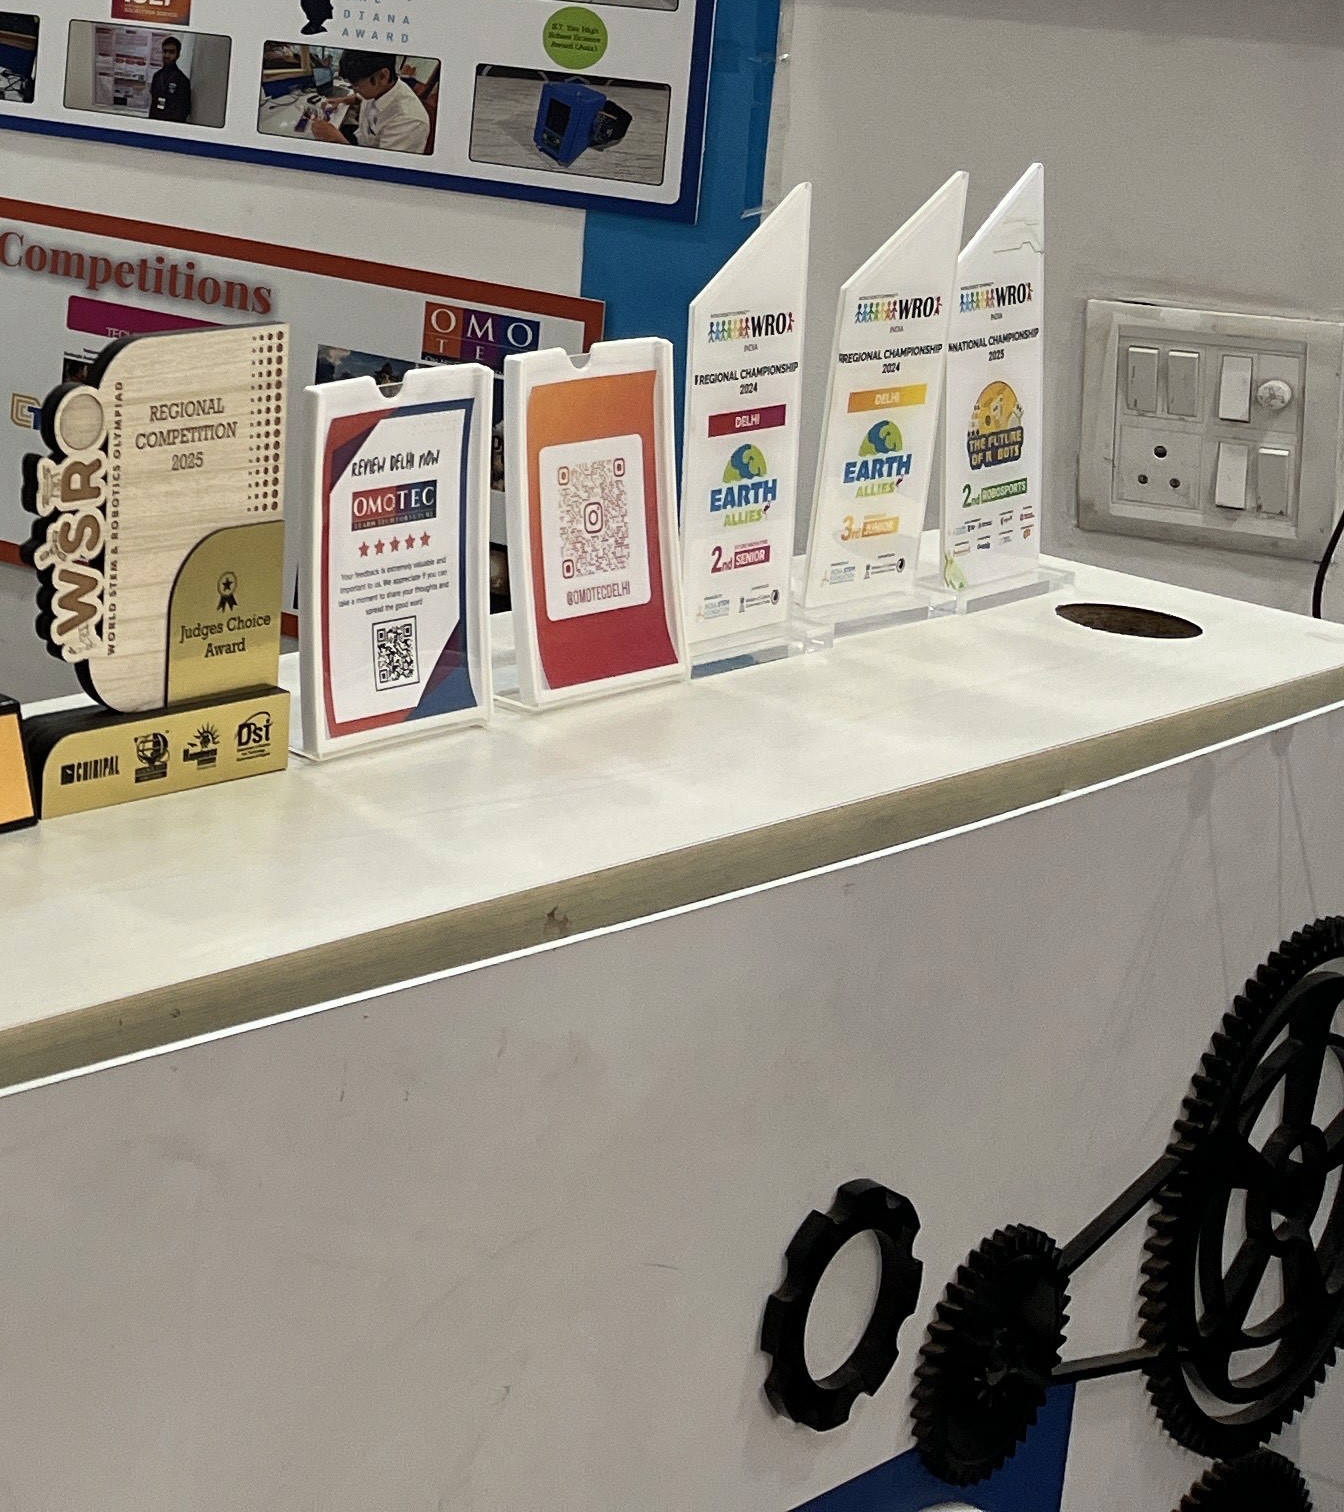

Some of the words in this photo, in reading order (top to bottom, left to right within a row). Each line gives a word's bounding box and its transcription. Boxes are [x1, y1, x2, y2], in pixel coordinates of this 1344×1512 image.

[343, 9, 411, 25] DIANA
[341, 27, 410, 44] AWARD
[995, 282, 1027, 308] WRO
[898, 296, 935, 321] WRO
[431, 306, 535, 349] OMO
[750, 311, 787, 339] WRO
[988, 327, 1040, 348] CHAMPIONSHIP
[883, 342, 944, 361] CHAMPIONSHIP
[698, 368, 740, 386] REGIONAL
[740, 361, 799, 382] CHAMPIONSHIP
[882, 362, 900, 374] 2024
[739, 383, 759, 395] 2024
[874, 391, 900, 406] DELHI
[148, 397, 225, 423] REGIONAL
[735, 414, 761, 430] DELHI
[134, 421, 238, 451] COMPETITION
[968, 437, 986, 453] THE
[986, 428, 1024, 450] FUTURE
[170, 452, 205, 472] 2025
[351, 456, 387, 477] REVIEW
[389, 451, 416, 472] DELHI
[842, 453, 913, 484] EARTH
[110, 464, 121, 541] ROBOTICS
[353, 486, 435, 517] OMOTEC
[709, 477, 778, 513] EARTH
[855, 482, 896, 499] ALLIES
[981, 479, 1028, 501] ROBOSPORTS
[723, 509, 764, 528] ALLIES
[863, 519, 896, 537] JUNIOR
[711, 544, 733, 574] 2nd
[734, 549, 766, 568] SENIOR
[109, 567, 119, 605] STEM
[566, 581, 632, 607] @OMOTECDELHI
[107, 607, 117, 656] WORLD
[179, 617, 223, 642] Judges
[226, 612, 272, 631] Choice
[204, 638, 247, 659] Award
